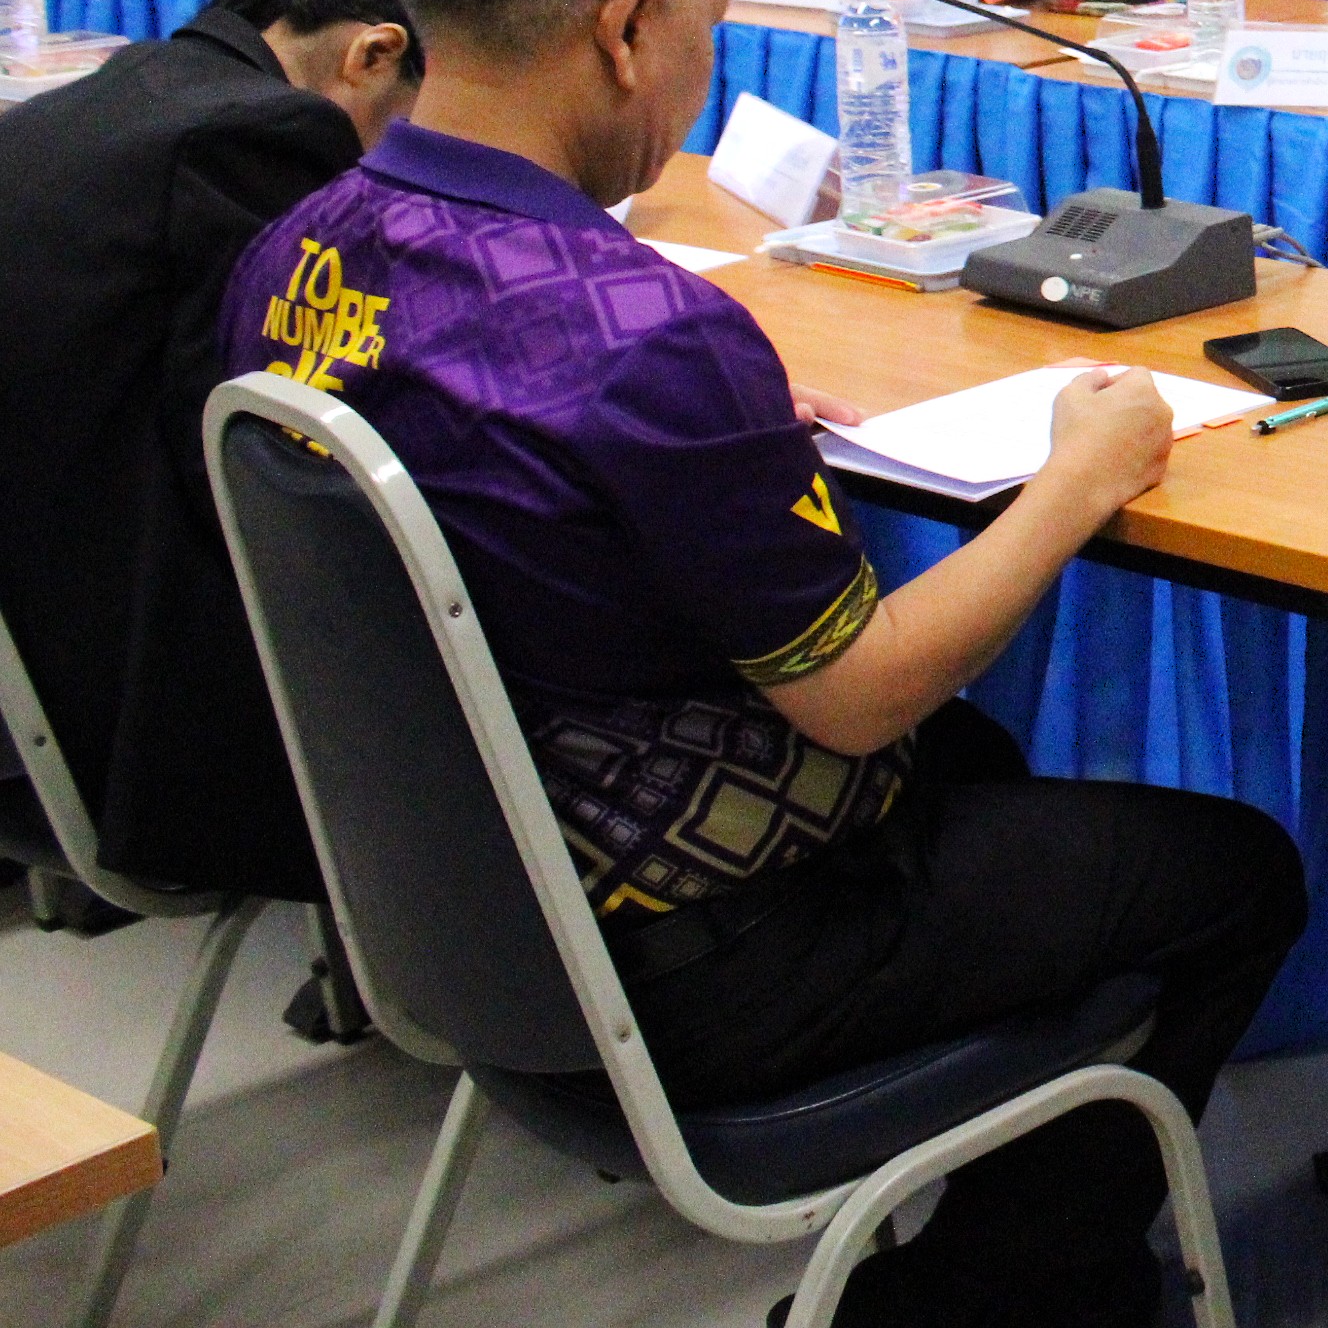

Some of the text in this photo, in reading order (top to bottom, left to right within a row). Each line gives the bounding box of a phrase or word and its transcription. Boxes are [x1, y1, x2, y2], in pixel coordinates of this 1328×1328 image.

[286, 237, 391, 337] TO BE
[261, 295, 386, 370] NUMBER
